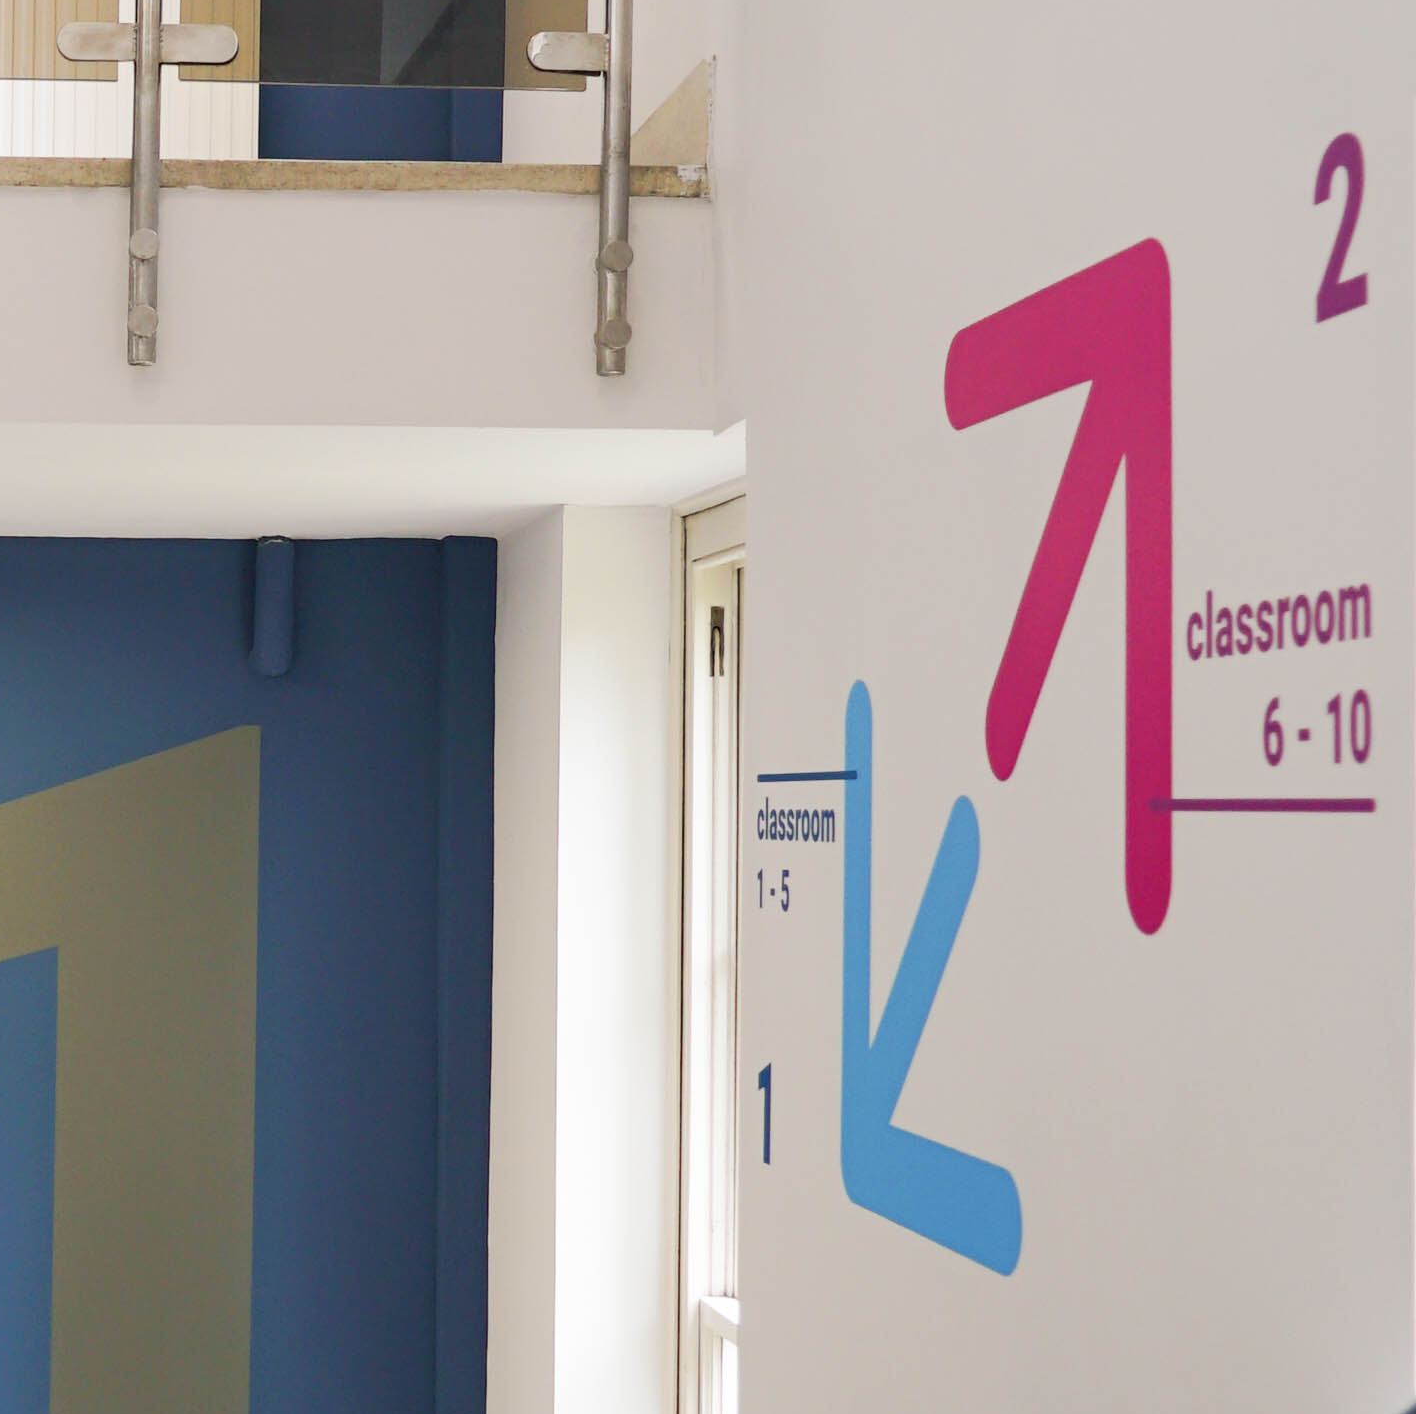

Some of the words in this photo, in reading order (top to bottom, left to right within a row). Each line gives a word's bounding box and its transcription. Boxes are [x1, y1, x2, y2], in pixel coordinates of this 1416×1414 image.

[1314, 132, 1368, 323] 2
[1186, 583, 1372, 661] classroom
[1263, 697, 1284, 767] 6
[1327, 689, 1372, 765] 10
[757, 796, 836, 842] classroom
[758, 1063, 771, 1165] 1
